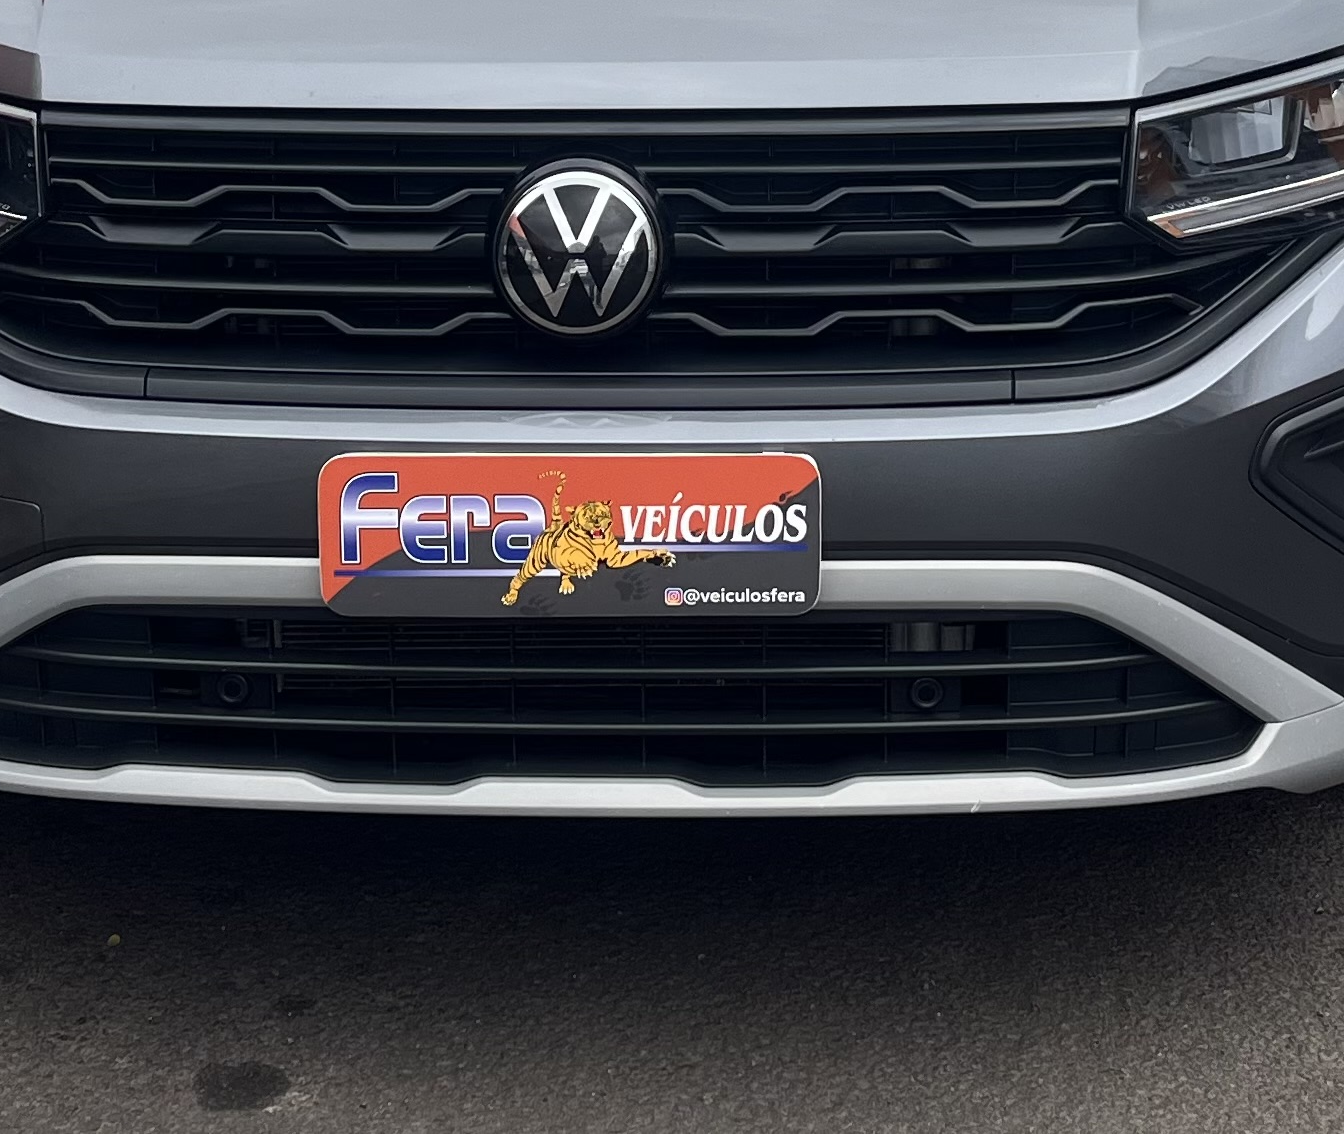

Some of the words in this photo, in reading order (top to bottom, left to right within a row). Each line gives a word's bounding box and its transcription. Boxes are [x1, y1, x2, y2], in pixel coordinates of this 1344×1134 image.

[339, 471, 546, 565] Fera
[619, 491, 808, 544] VEÍCULOS
[683, 586, 806, 606] @veiculosfera
